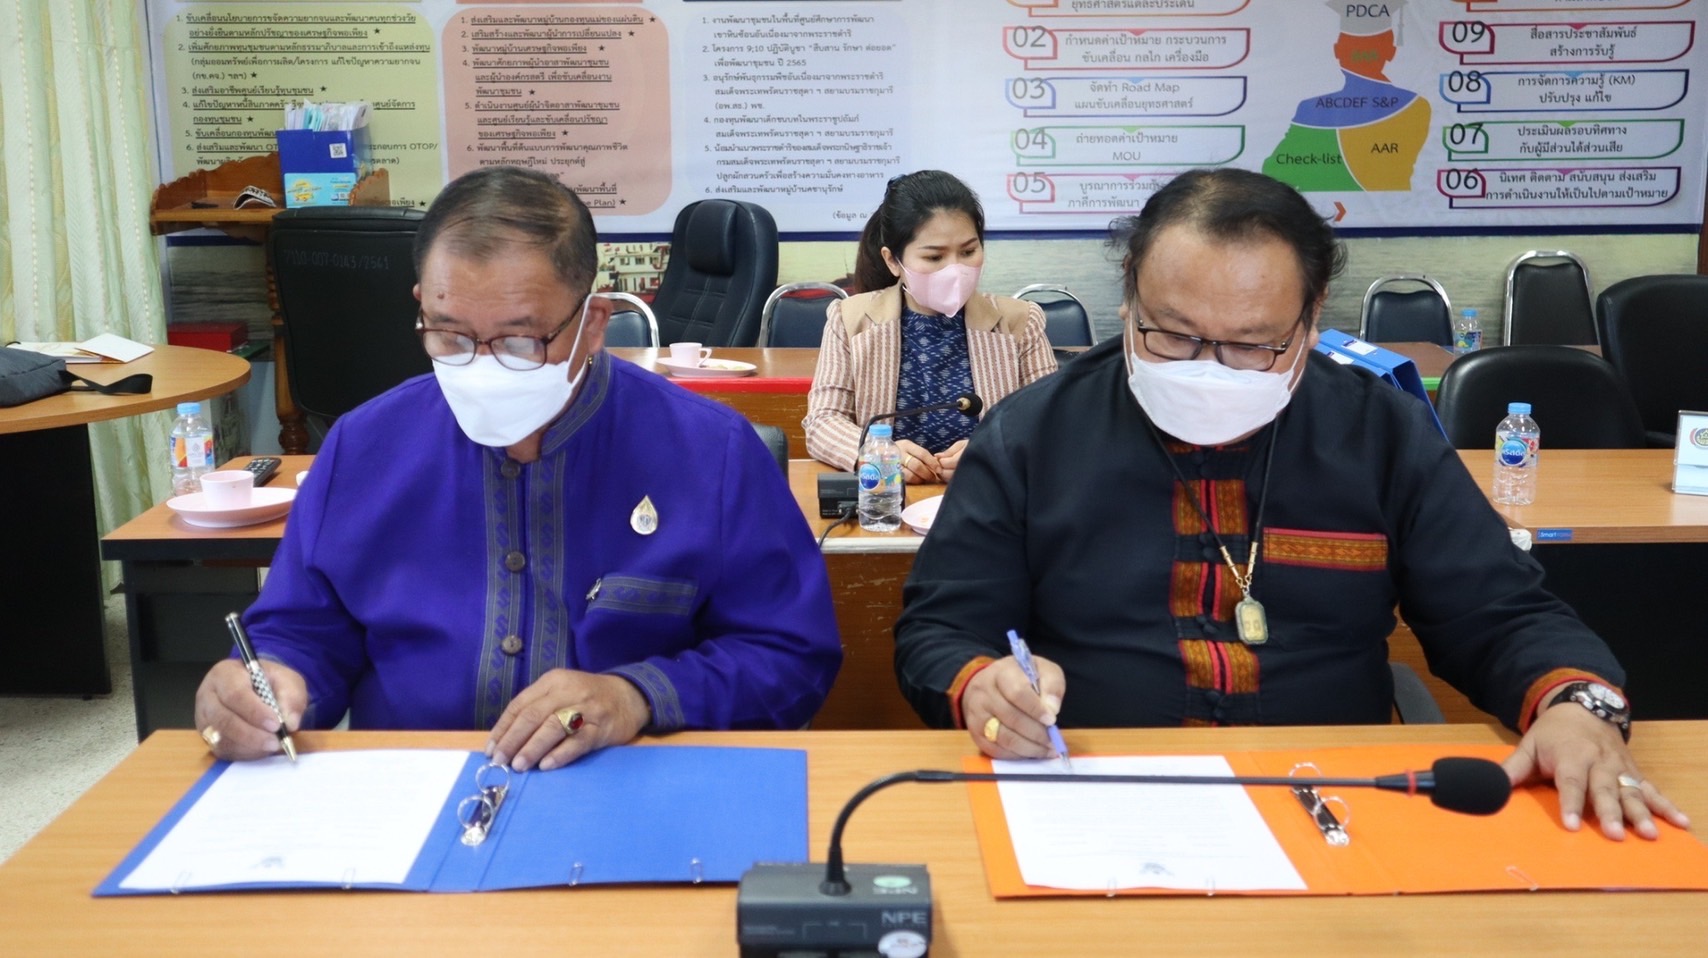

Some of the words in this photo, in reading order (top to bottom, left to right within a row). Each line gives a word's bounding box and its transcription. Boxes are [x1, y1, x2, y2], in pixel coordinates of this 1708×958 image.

[1346, 4, 1390, 17] PDCA
[1013, 25, 1046, 48] 02
[1452, 20, 1486, 43] 09
[1530, 26, 1637, 40] สื่อสารประชาสัมพันธ์
[1065, 33, 1162, 45] กำหนดค่าเป้าหมาย
[1166, 36, 1227, 45] กระบวนการ
[178, 43, 185, 51] 2.
[702, 45, 709, 53] 2.
[712, 44, 743, 52] โครงการ
[843, 43, 863, 52] รักษา
[1550, 44, 1615, 60] สร้างการรับรู้
[1082, 49, 1131, 63] ขับเคลื่อน
[1135, 50, 1161, 62] กลไก
[1165, 48, 1209, 62] เครื่องมือ
[714, 57, 774, 68] เพื่อพัฒนาชุมชน
[777, 58, 784, 67] ปี
[1448, 70, 1481, 92] 08
[1518, 73, 1604, 88] การจัดการความรู้
[1609, 75, 1636, 86] (KM)
[181, 86, 189, 94] 3.
[476, 86, 522, 96] พัฒนาชุมชน
[1012, 77, 1045, 99] 03
[1090, 81, 1118, 93] จัดทำ
[1121, 82, 1151, 93] Road
[1155, 83, 1180, 95] Map
[1074, 96, 1193, 111] แผนขับเคลื่อนยุทธศาสตร์
[1315, 97, 1368, 108] ABCDEF
[1372, 97, 1399, 108] S&P
[1539, 91, 1580, 106] ปรับปรุง
[1585, 91, 1612, 103] แก้ไข
[185, 129, 192, 137] 5.
[1450, 122, 1484, 145] 07
[1517, 124, 1627, 136] ประเมินผลรอบทิศทาง
[1014, 128, 1047, 150] 04
[1075, 131, 1178, 144] ถ่ายทอดค่าเป้าหมาย
[186, 143, 193, 151] 6.
[409, 142, 438, 151] OTOP/
[466, 144, 474, 152] 6.
[1370, 143, 1399, 154] AAR
[1519, 141, 1623, 157] กับผู้มีส่วนได้ส่วนเสีย
[1112, 151, 1141, 161] MOU
[1276, 153, 1342, 165] Check-list
[1013, 171, 1046, 193] 05
[1446, 168, 1478, 190] 06
[1499, 171, 1526, 183] นิเทศ
[1530, 171, 1565, 183] ติดตาม
[1569, 169, 1615, 185] สนับสนุน
[1619, 169, 1656, 182] ส่งเสริม
[1486, 187, 1668, 200] การดำเนินงานให้เป็นไปตามเป้าหมาย
[1067, 196, 1140, 208] ภาคีการพัฒนา
[881, 911, 927, 925] NPE
